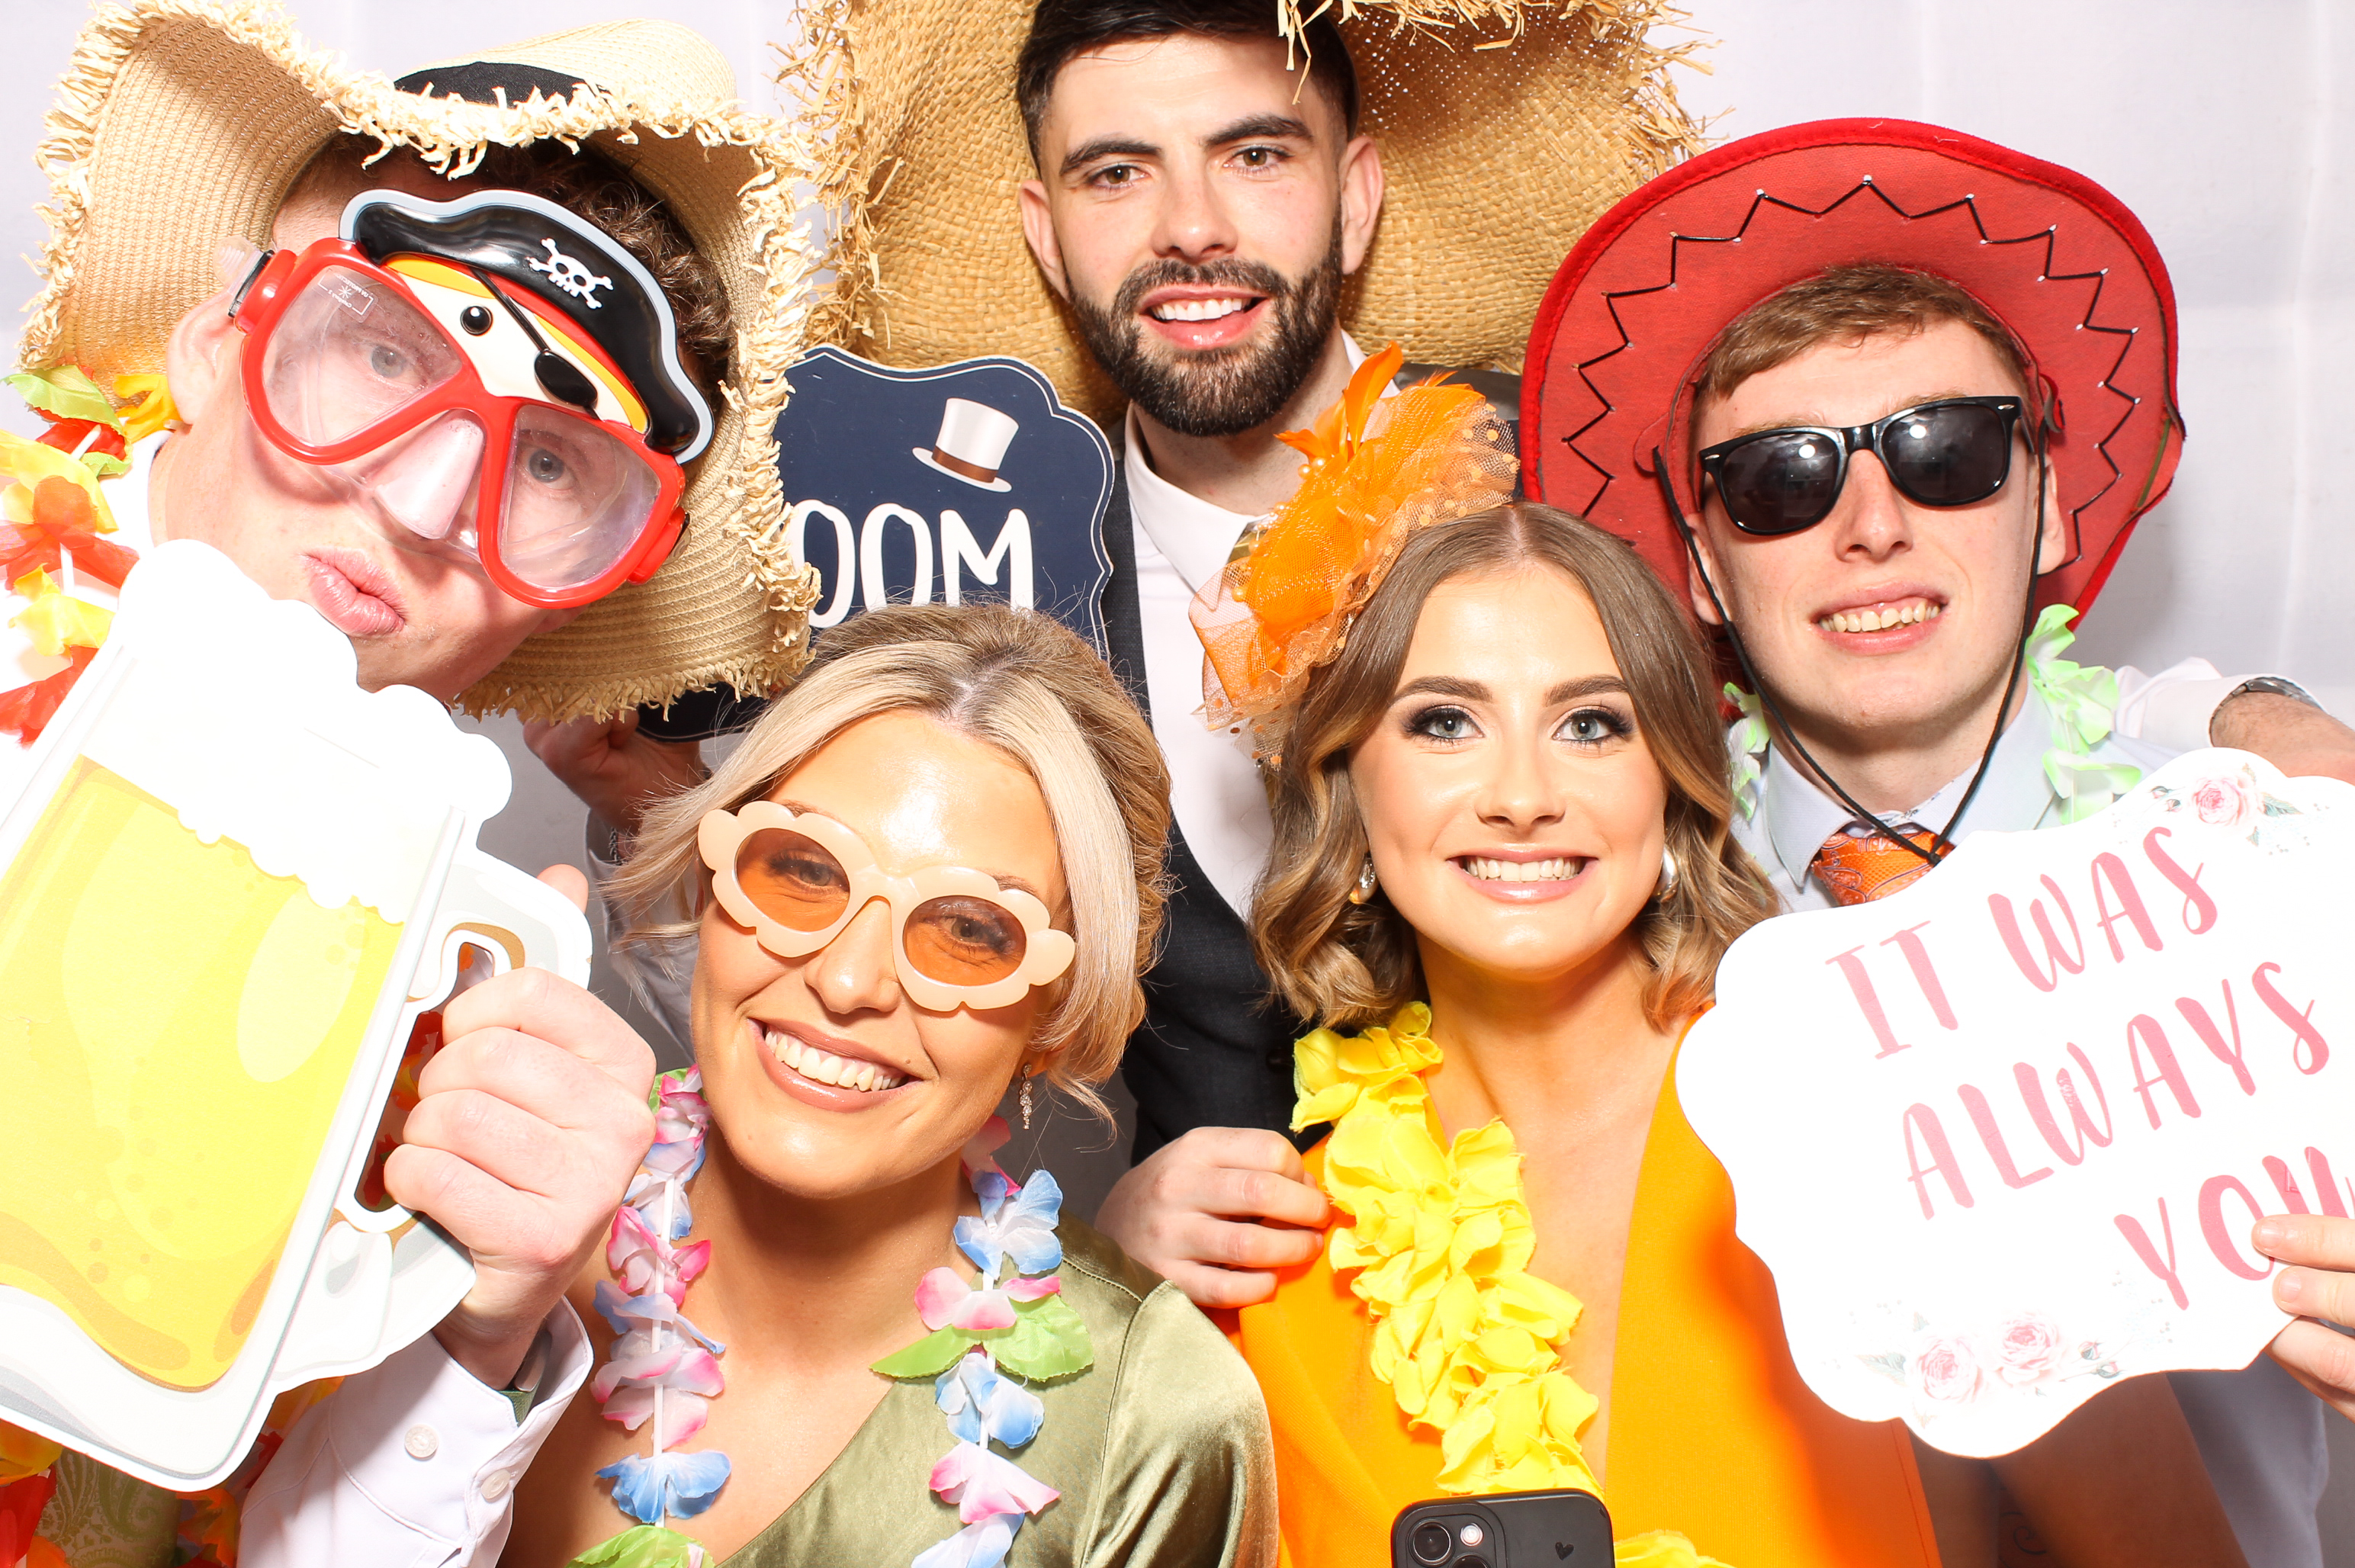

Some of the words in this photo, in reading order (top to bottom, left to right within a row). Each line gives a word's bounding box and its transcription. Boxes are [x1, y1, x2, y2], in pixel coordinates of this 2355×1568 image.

[1826, 921, 1958, 1059] IT
[1987, 827, 2218, 992] WAS
[1904, 962, 2330, 1220] ALWAYS
